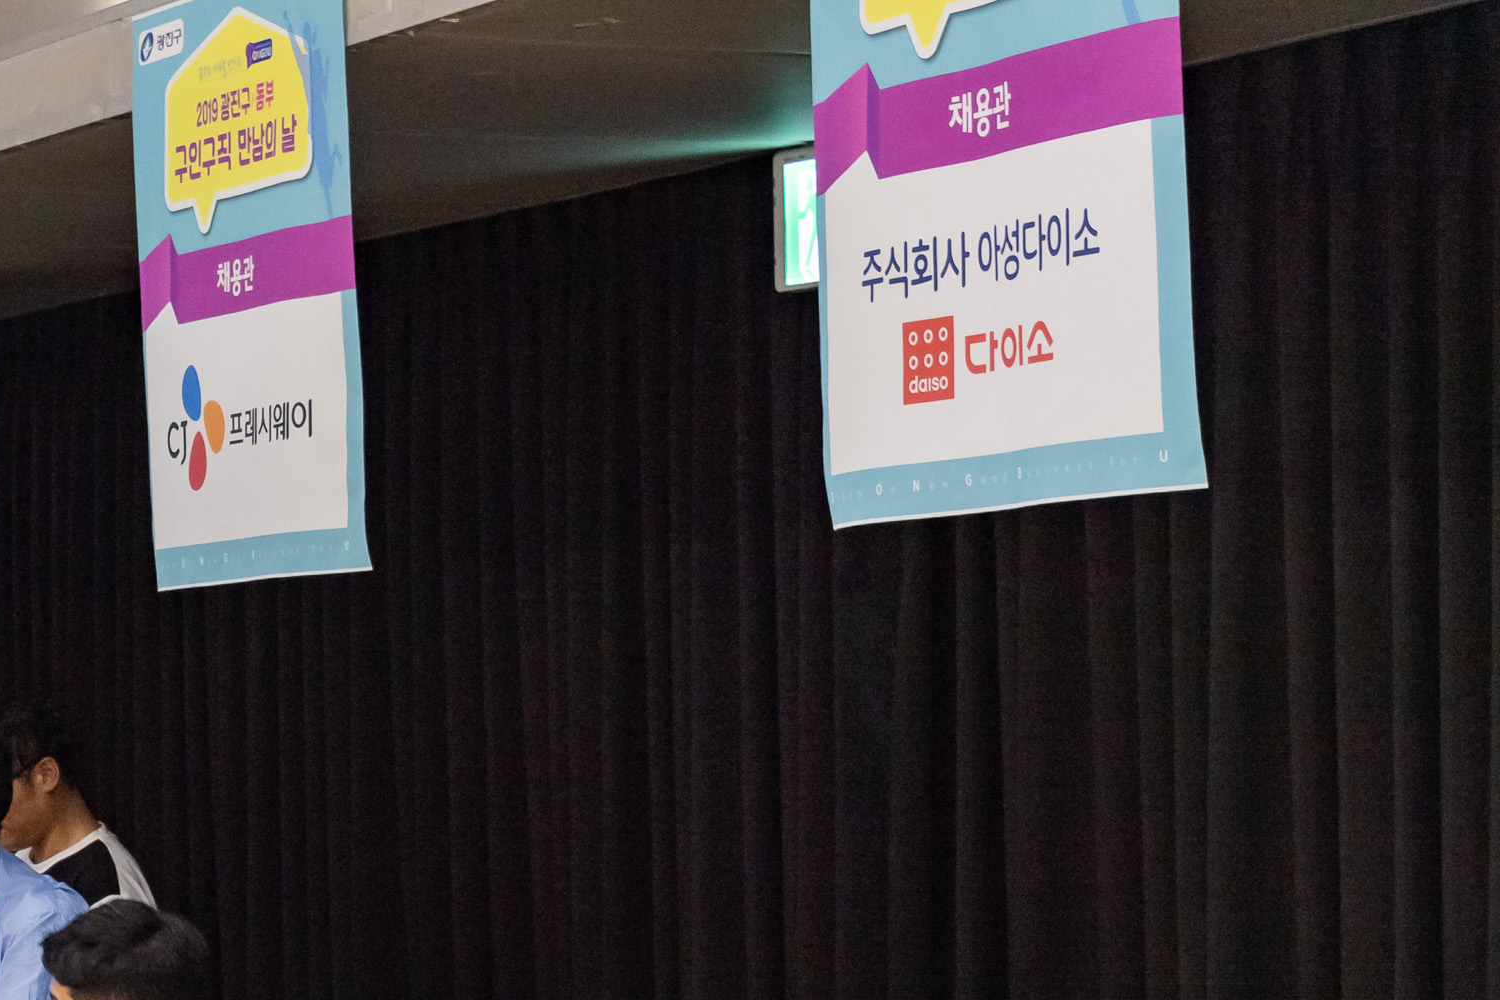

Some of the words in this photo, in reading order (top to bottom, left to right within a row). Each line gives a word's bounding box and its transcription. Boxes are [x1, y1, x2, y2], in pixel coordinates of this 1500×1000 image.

[156, 28, 182, 52] 광진구
[196, 98, 218, 127] 2019
[220, 87, 251, 122] 광진구
[256, 79, 274, 112] 동부
[948, 81, 1011, 137] 채용관
[174, 131, 232, 183] 구인구직
[238, 119, 277, 166] 만남의
[281, 114, 297, 153] 날
[216, 255, 255, 297] 채용관
[861, 230, 970, 303] 주식회사
[978, 207, 1100, 281] 아성다이소
[964, 320, 1055, 375] 다이소
[908, 374, 949, 395] daiso
[167, 420, 189, 466] CJ
[228, 398, 312, 446] 프레시웨이
